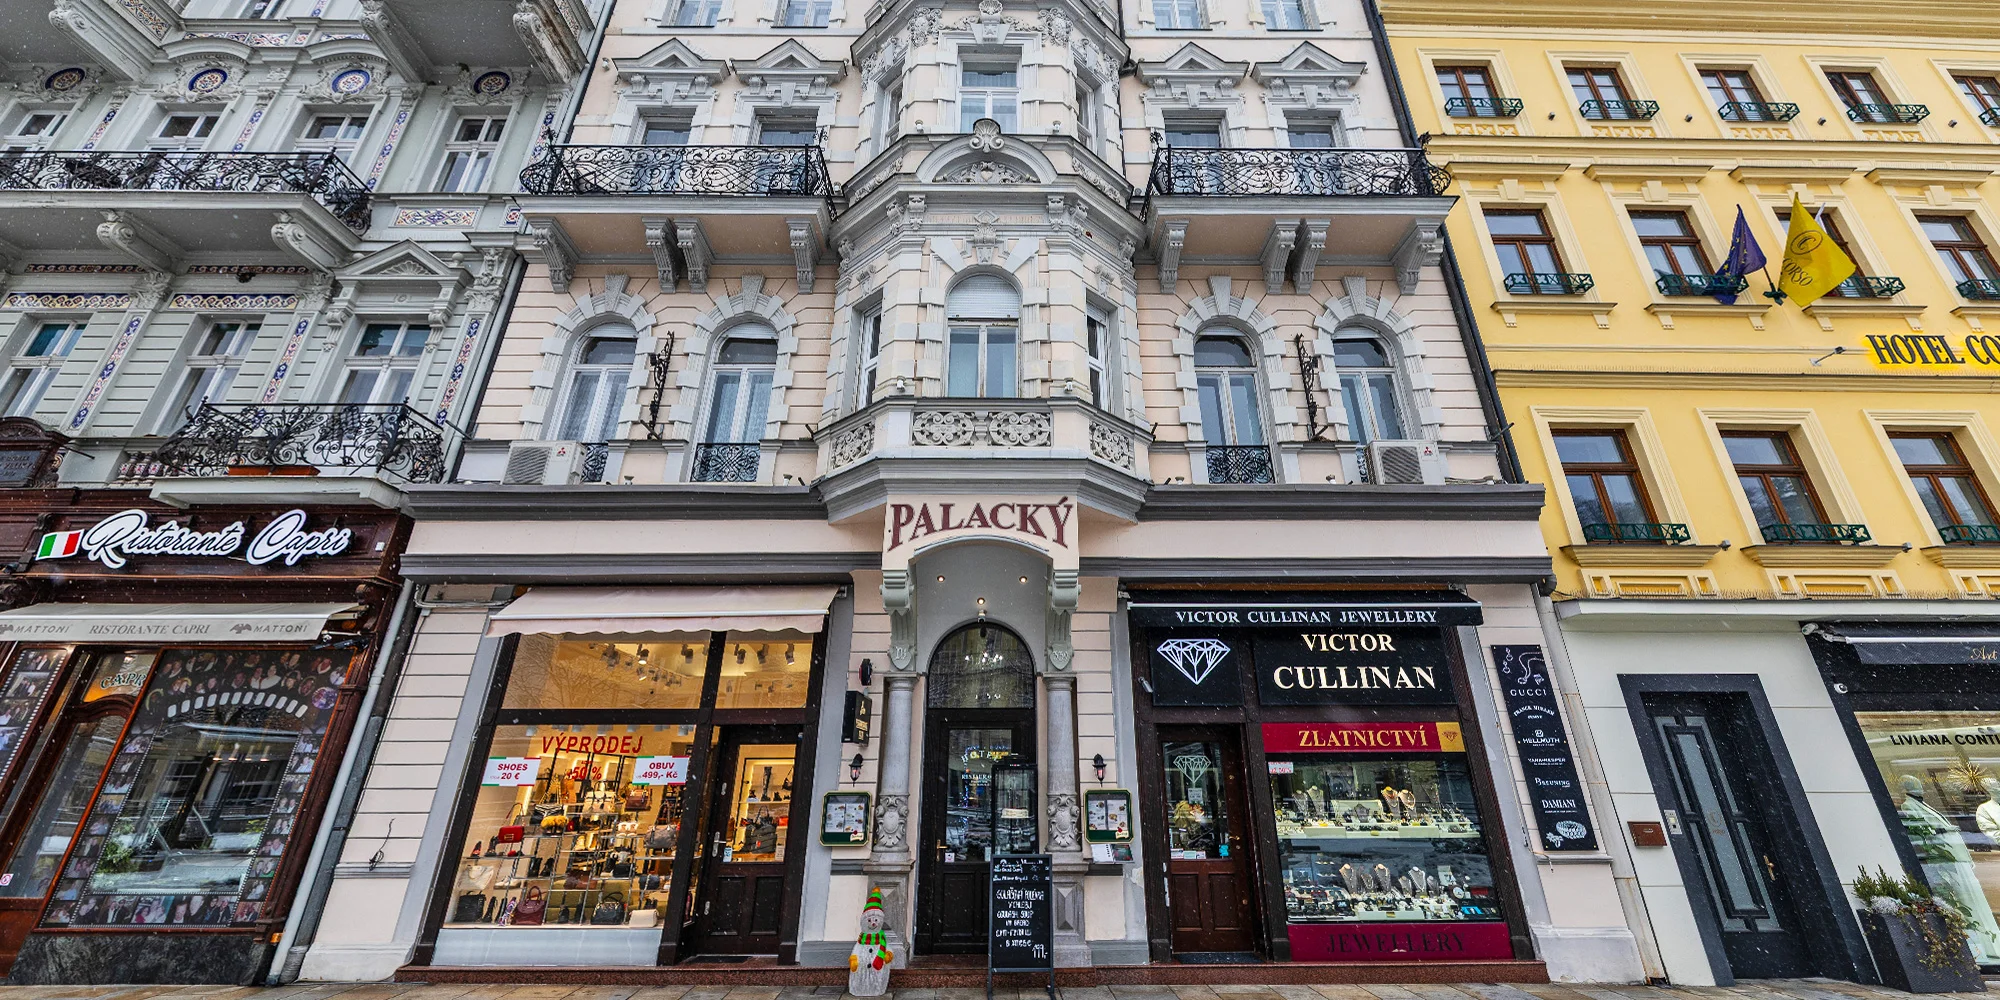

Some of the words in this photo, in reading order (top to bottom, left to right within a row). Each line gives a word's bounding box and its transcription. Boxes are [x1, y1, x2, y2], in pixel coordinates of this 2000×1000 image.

[1865, 334, 1966, 365] HOTEL
[1965, 334, 2000, 366] CO
[887, 495, 1074, 552] PALACKÝ
[81, 508, 246, 569] Ristorante
[246, 508, 351, 566] Capri
[1175, 610, 1240, 624] VICTOR
[1247, 610, 1331, 624] CULLINAN
[1339, 610, 1438, 624] JEWELLERY
[14, 624, 71, 634] MATTONI
[88, 624, 169, 635] RISTORANTE
[171, 624, 211, 635] CAPRI
[253, 624, 309, 633] MATTONI
[1300, 633, 1396, 652] VICTOR
[100, 672, 147, 689] CAPR
[1273, 665, 1437, 690] CULLINAN
[1510, 688, 1547, 697] GUCCI
[1298, 725, 1428, 747] ZLATNICTVÍ
[1889, 734, 1953, 746] LIVIANA
[542, 733, 643, 754] VÝPRODEJ
[497, 763, 528, 771] SHOES
[649, 762, 675, 770] OBUV
[501, 772, 512, 780] 20
[514, 772, 520, 780] €
[642, 771, 664, 780] 499,-
[665, 770, 678, 779] Kč
[1541, 799, 1576, 809] DAMIANI
[1327, 934, 1465, 952] JEWELLERY
